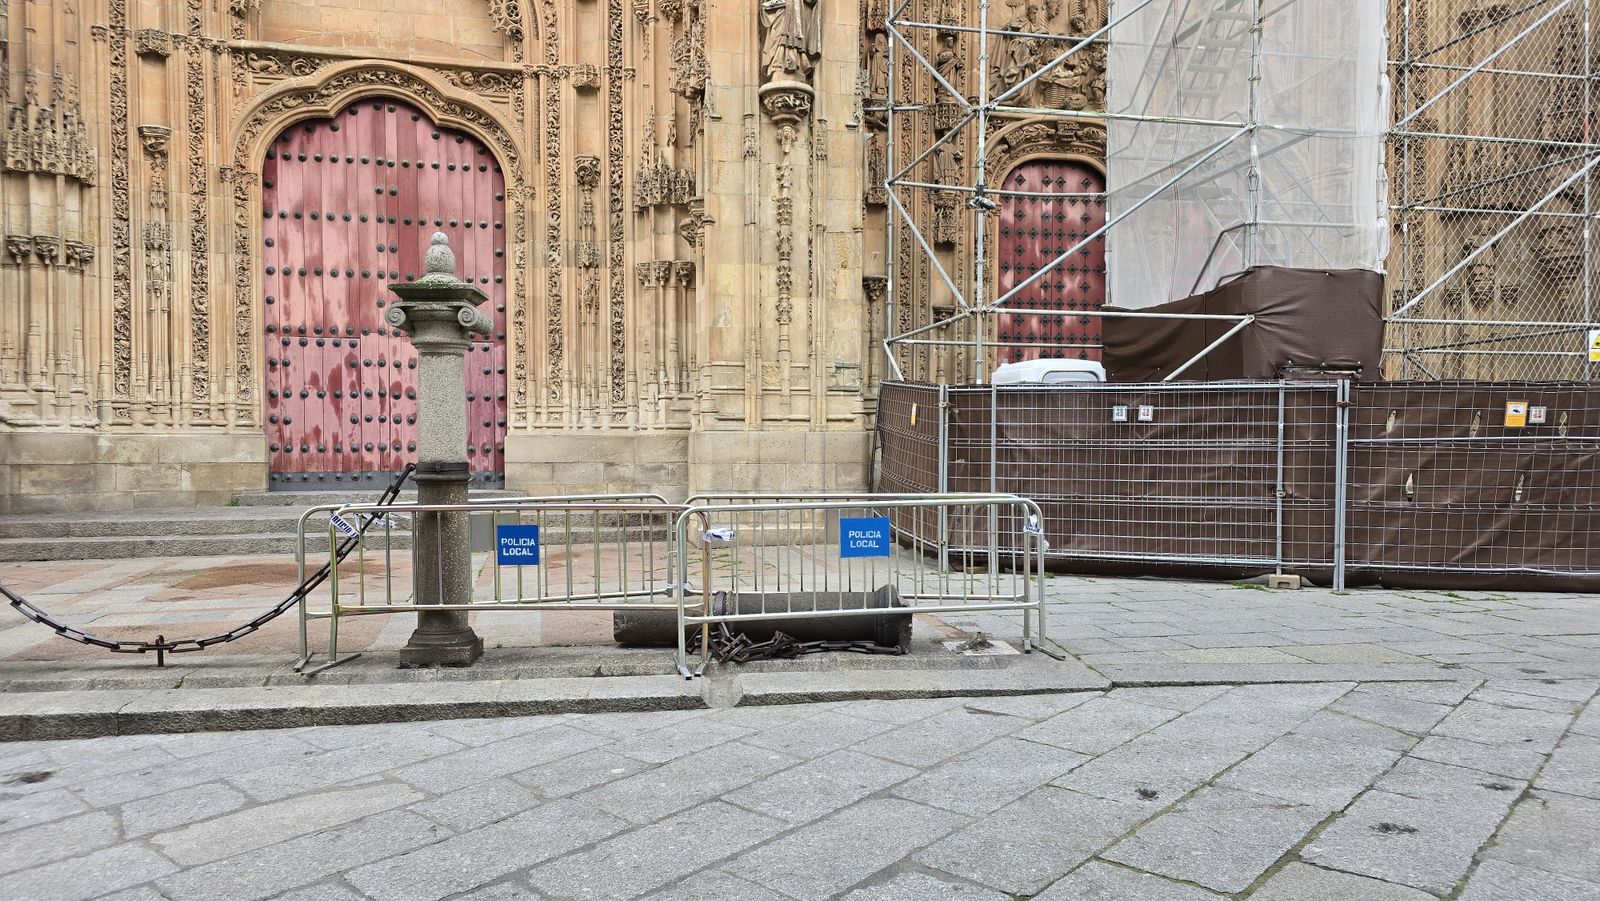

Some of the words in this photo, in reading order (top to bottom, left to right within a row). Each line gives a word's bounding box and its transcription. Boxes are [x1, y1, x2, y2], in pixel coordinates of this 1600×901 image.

[848, 530, 882, 539] POLICIA
[501, 537, 536, 546] POLICIA
[850, 540, 880, 548] LOCAL
[502, 547, 534, 556] LOCAL
